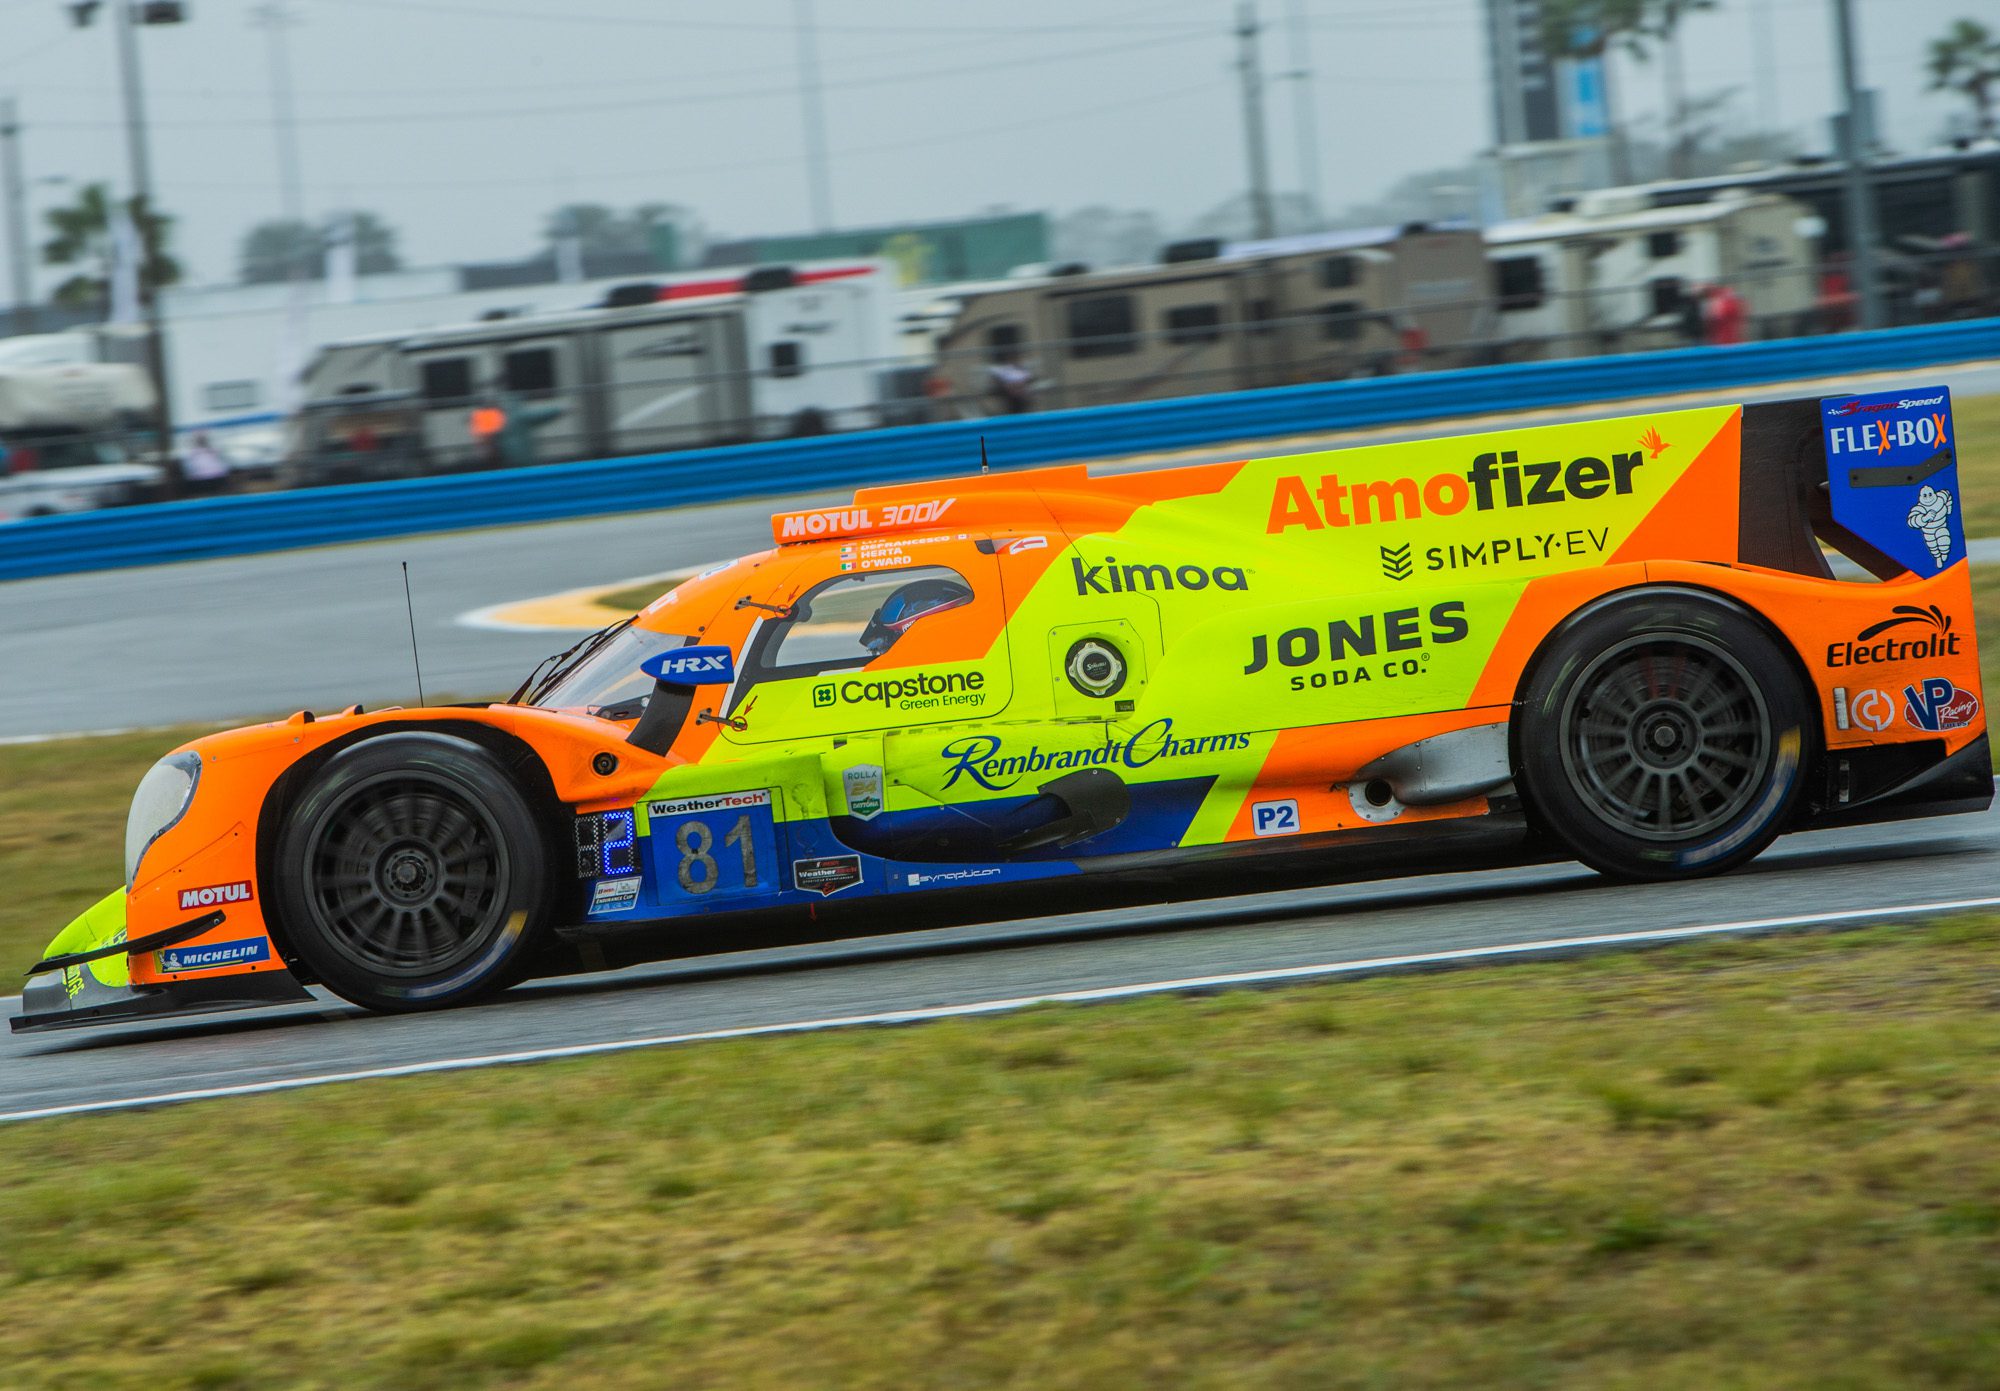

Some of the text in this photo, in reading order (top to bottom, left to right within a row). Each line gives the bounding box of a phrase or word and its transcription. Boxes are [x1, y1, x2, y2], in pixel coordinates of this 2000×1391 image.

[1830, 413, 1947, 455] FLEX-BOX
[1266, 450, 1644, 534] Atmofizer
[781, 498, 956, 537] MOTUL 300V
[861, 547, 902, 559] HERTA
[861, 555, 912, 569] O'WARD
[1071, 556, 1249, 596] kimoa
[1244, 601, 1469, 675] JONES
[1826, 632, 1960, 668] Electrolit
[660, 654, 728, 675] HRX
[1290, 667, 1371, 691] SODA
[841, 671, 985, 708] Capstone
[900, 693, 986, 710] Green Energy
[1903, 678, 1976, 731] VP Racing
[939, 717, 1251, 791] Rembrandt Charms
[652, 793, 764, 815] WeatherTech
[1257, 806, 1295, 830] P2
[676, 815, 758, 894] 81
[919, 868, 1001, 883] synapticon
[181, 883, 250, 908] MOTUL
[183, 945, 258, 965] MICHELIN
